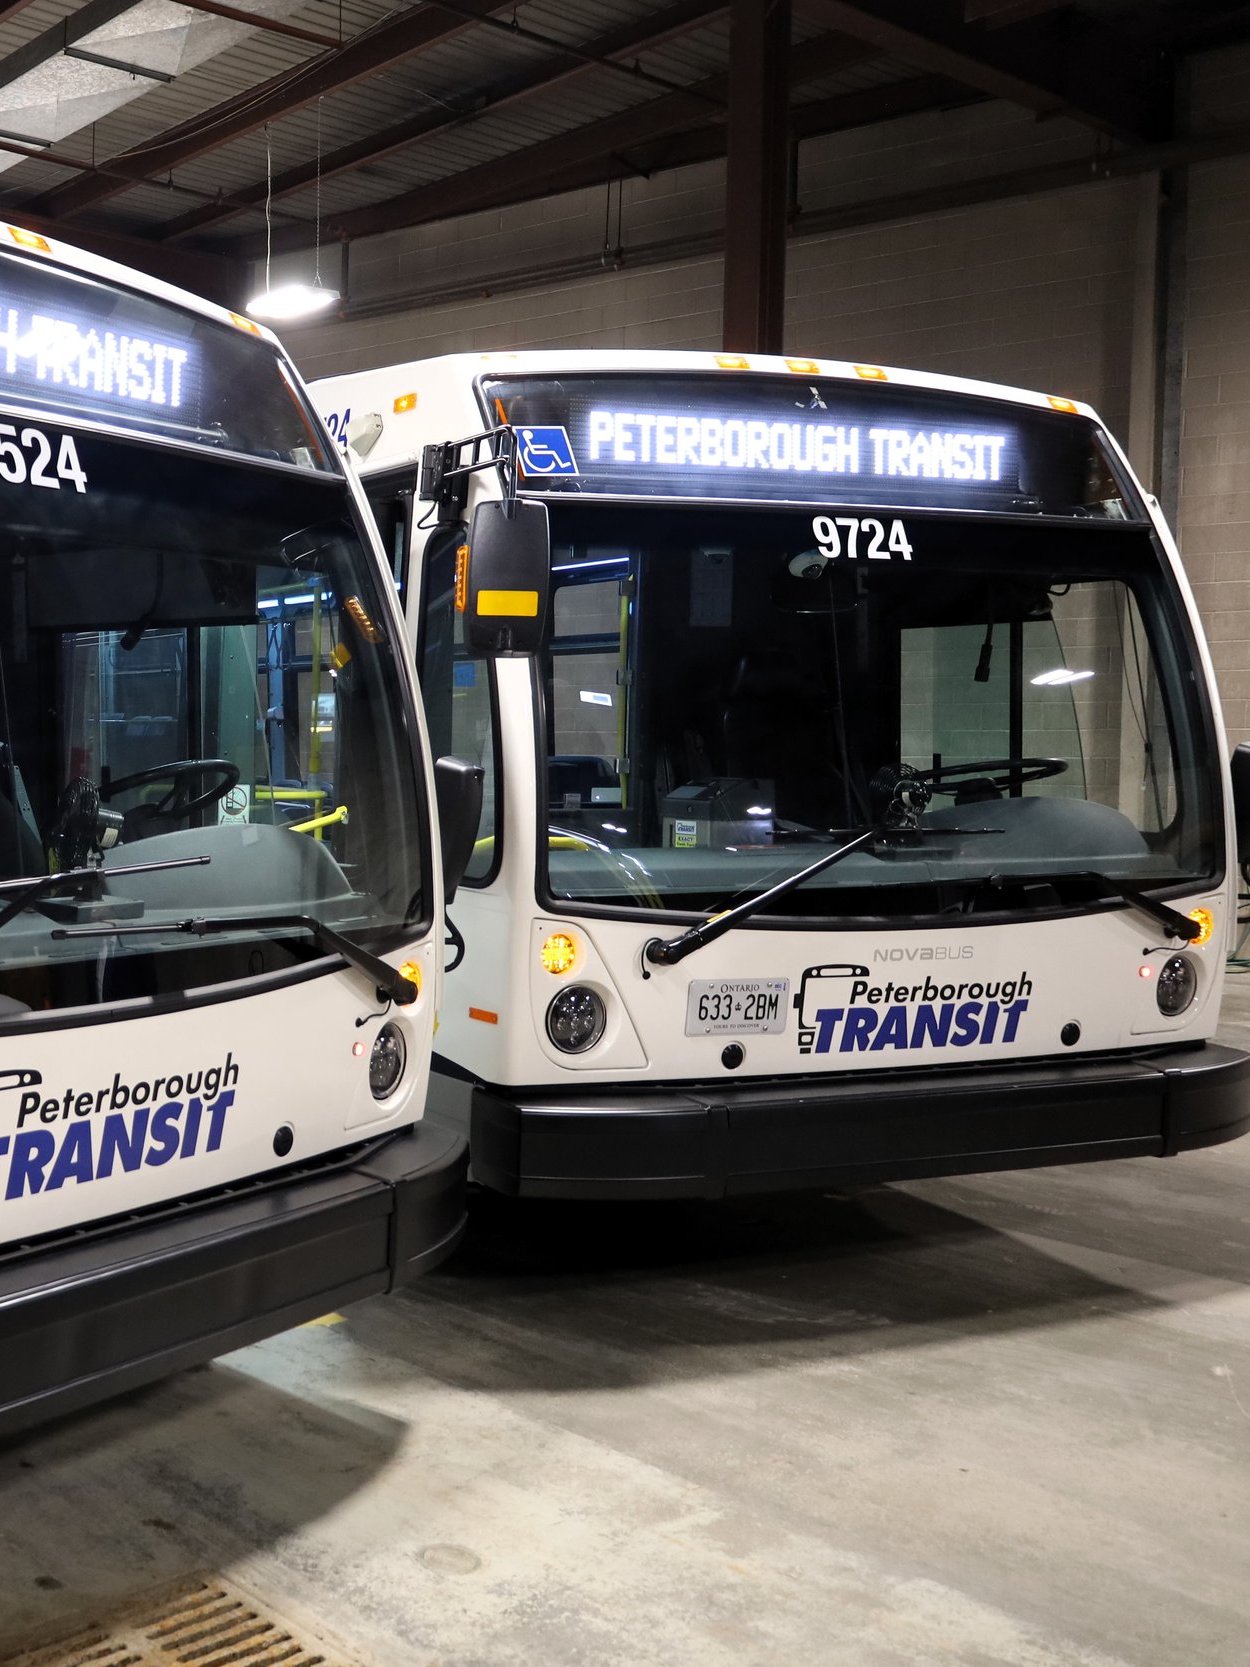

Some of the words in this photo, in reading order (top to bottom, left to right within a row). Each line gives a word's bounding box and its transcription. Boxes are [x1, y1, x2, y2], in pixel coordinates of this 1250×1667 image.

[30, 311, 188, 408] TRANSIT
[589, 410, 860, 474] PETERBOROUGH
[868, 428, 1006, 481] TRANSIT
[812, 515, 913, 561] 9724
[698, 993, 733, 1021] 633
[744, 993, 779, 1021] 2BM
[720, 983, 760, 993] ONTARIO
[849, 971, 1033, 1005] Peterborough
[814, 998, 1029, 1054] TRANSIT
[16, 1052, 240, 1128] Peterborough
